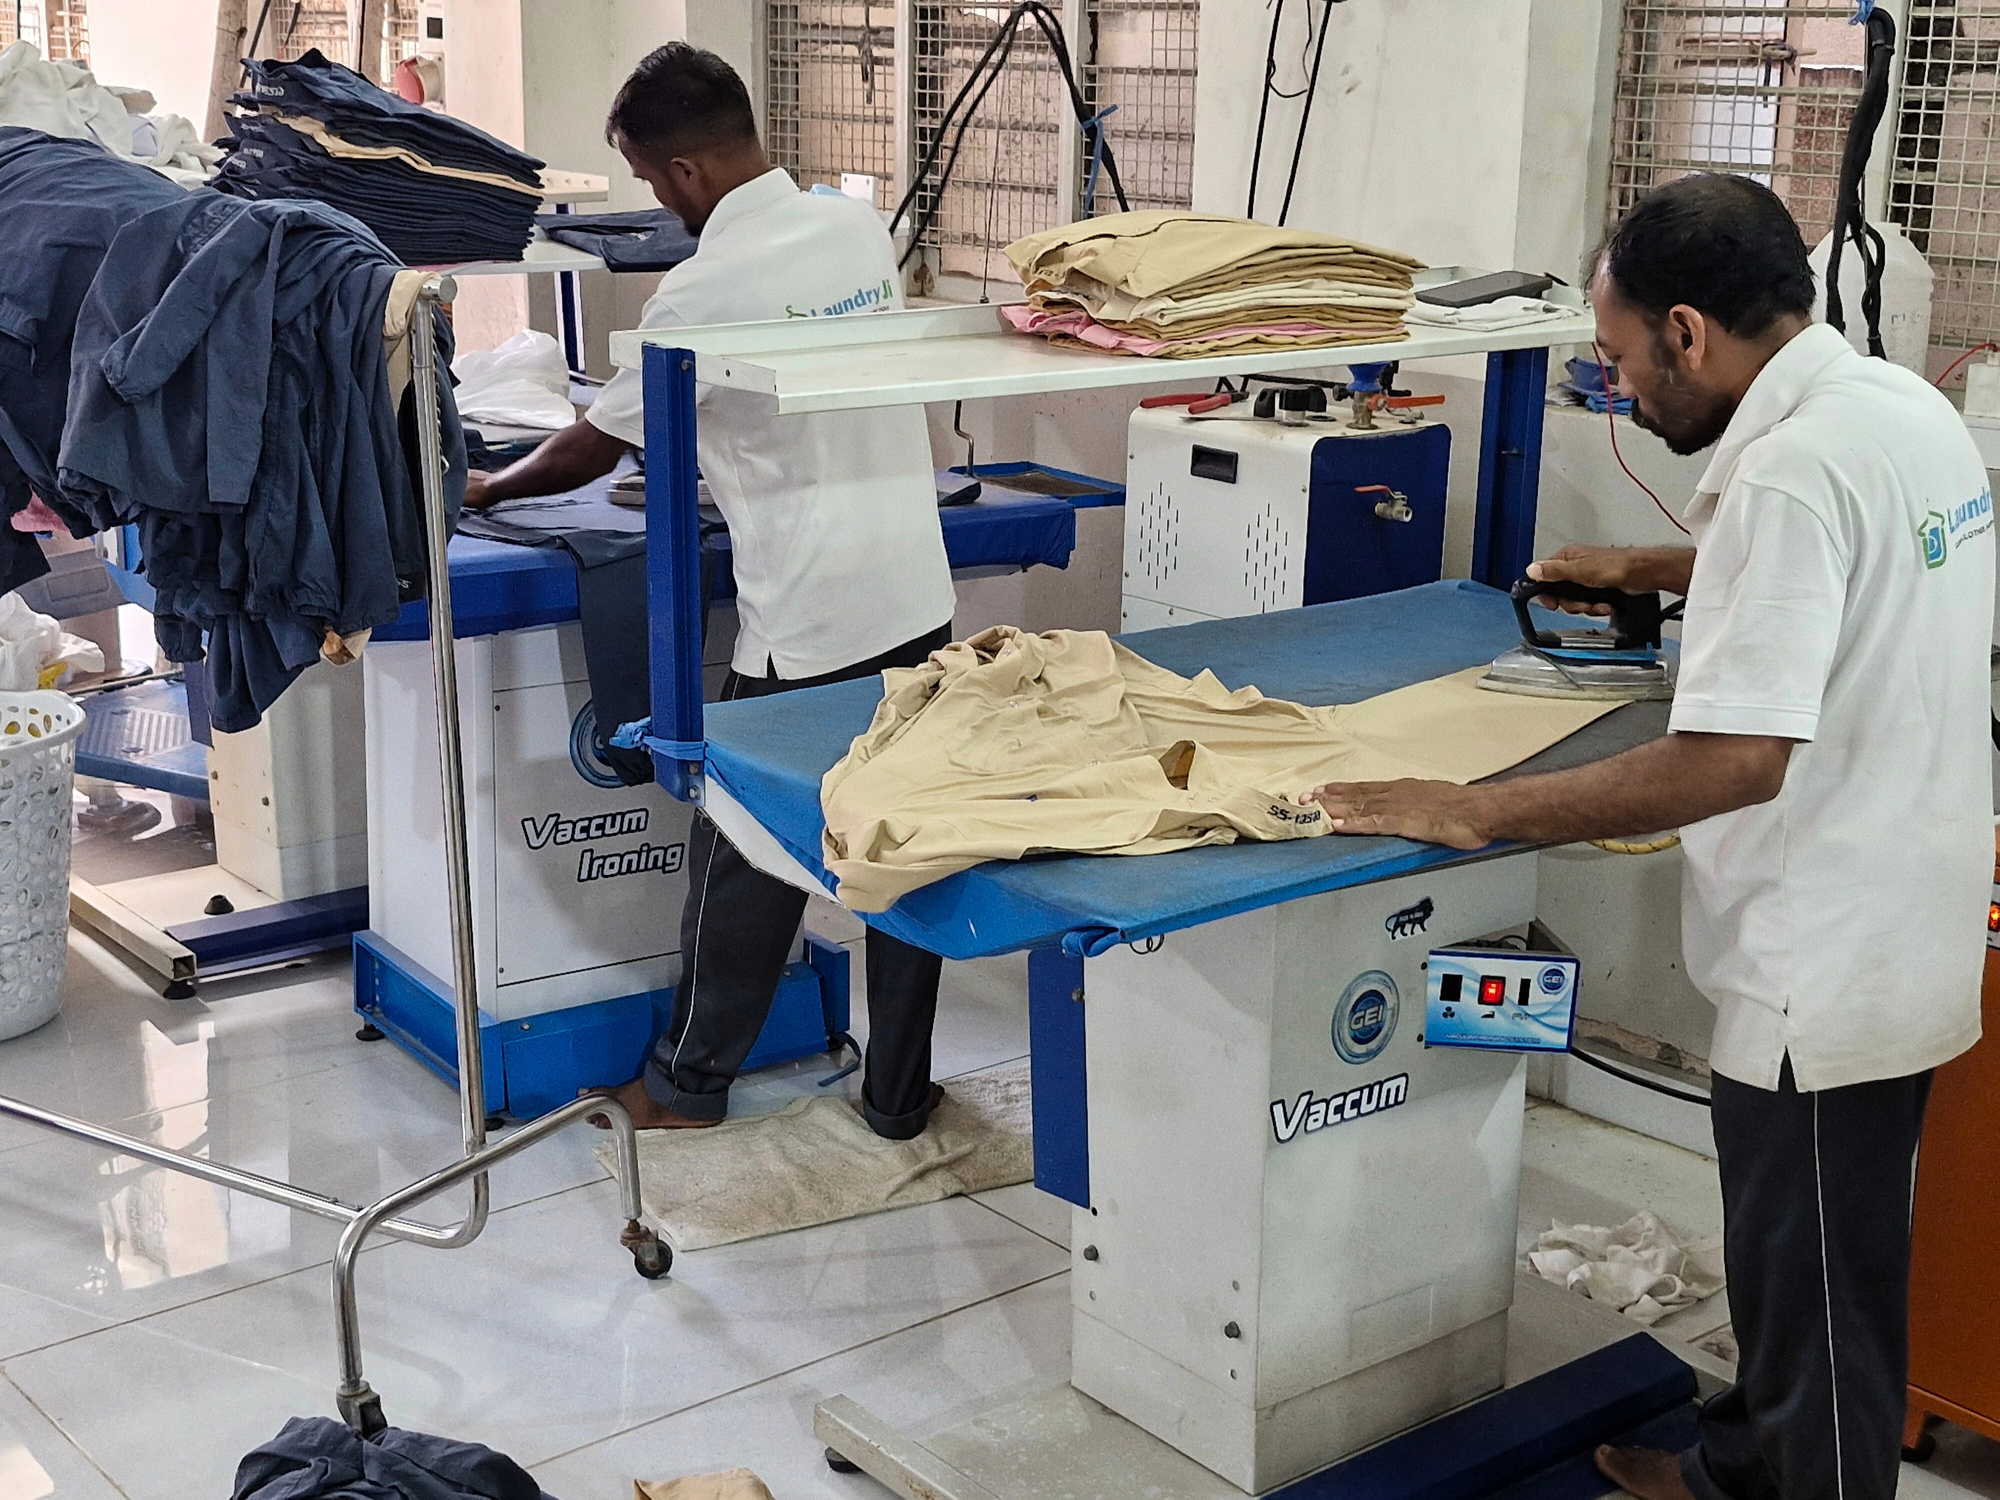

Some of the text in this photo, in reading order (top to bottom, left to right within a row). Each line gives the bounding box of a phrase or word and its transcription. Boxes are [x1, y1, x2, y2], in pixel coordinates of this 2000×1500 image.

[521, 808, 649, 850] Vaccum
[577, 842, 685, 882] Ironing
[1350, 1003, 1384, 1031] GEI
[1270, 1072, 1409, 1144] Vaccum
